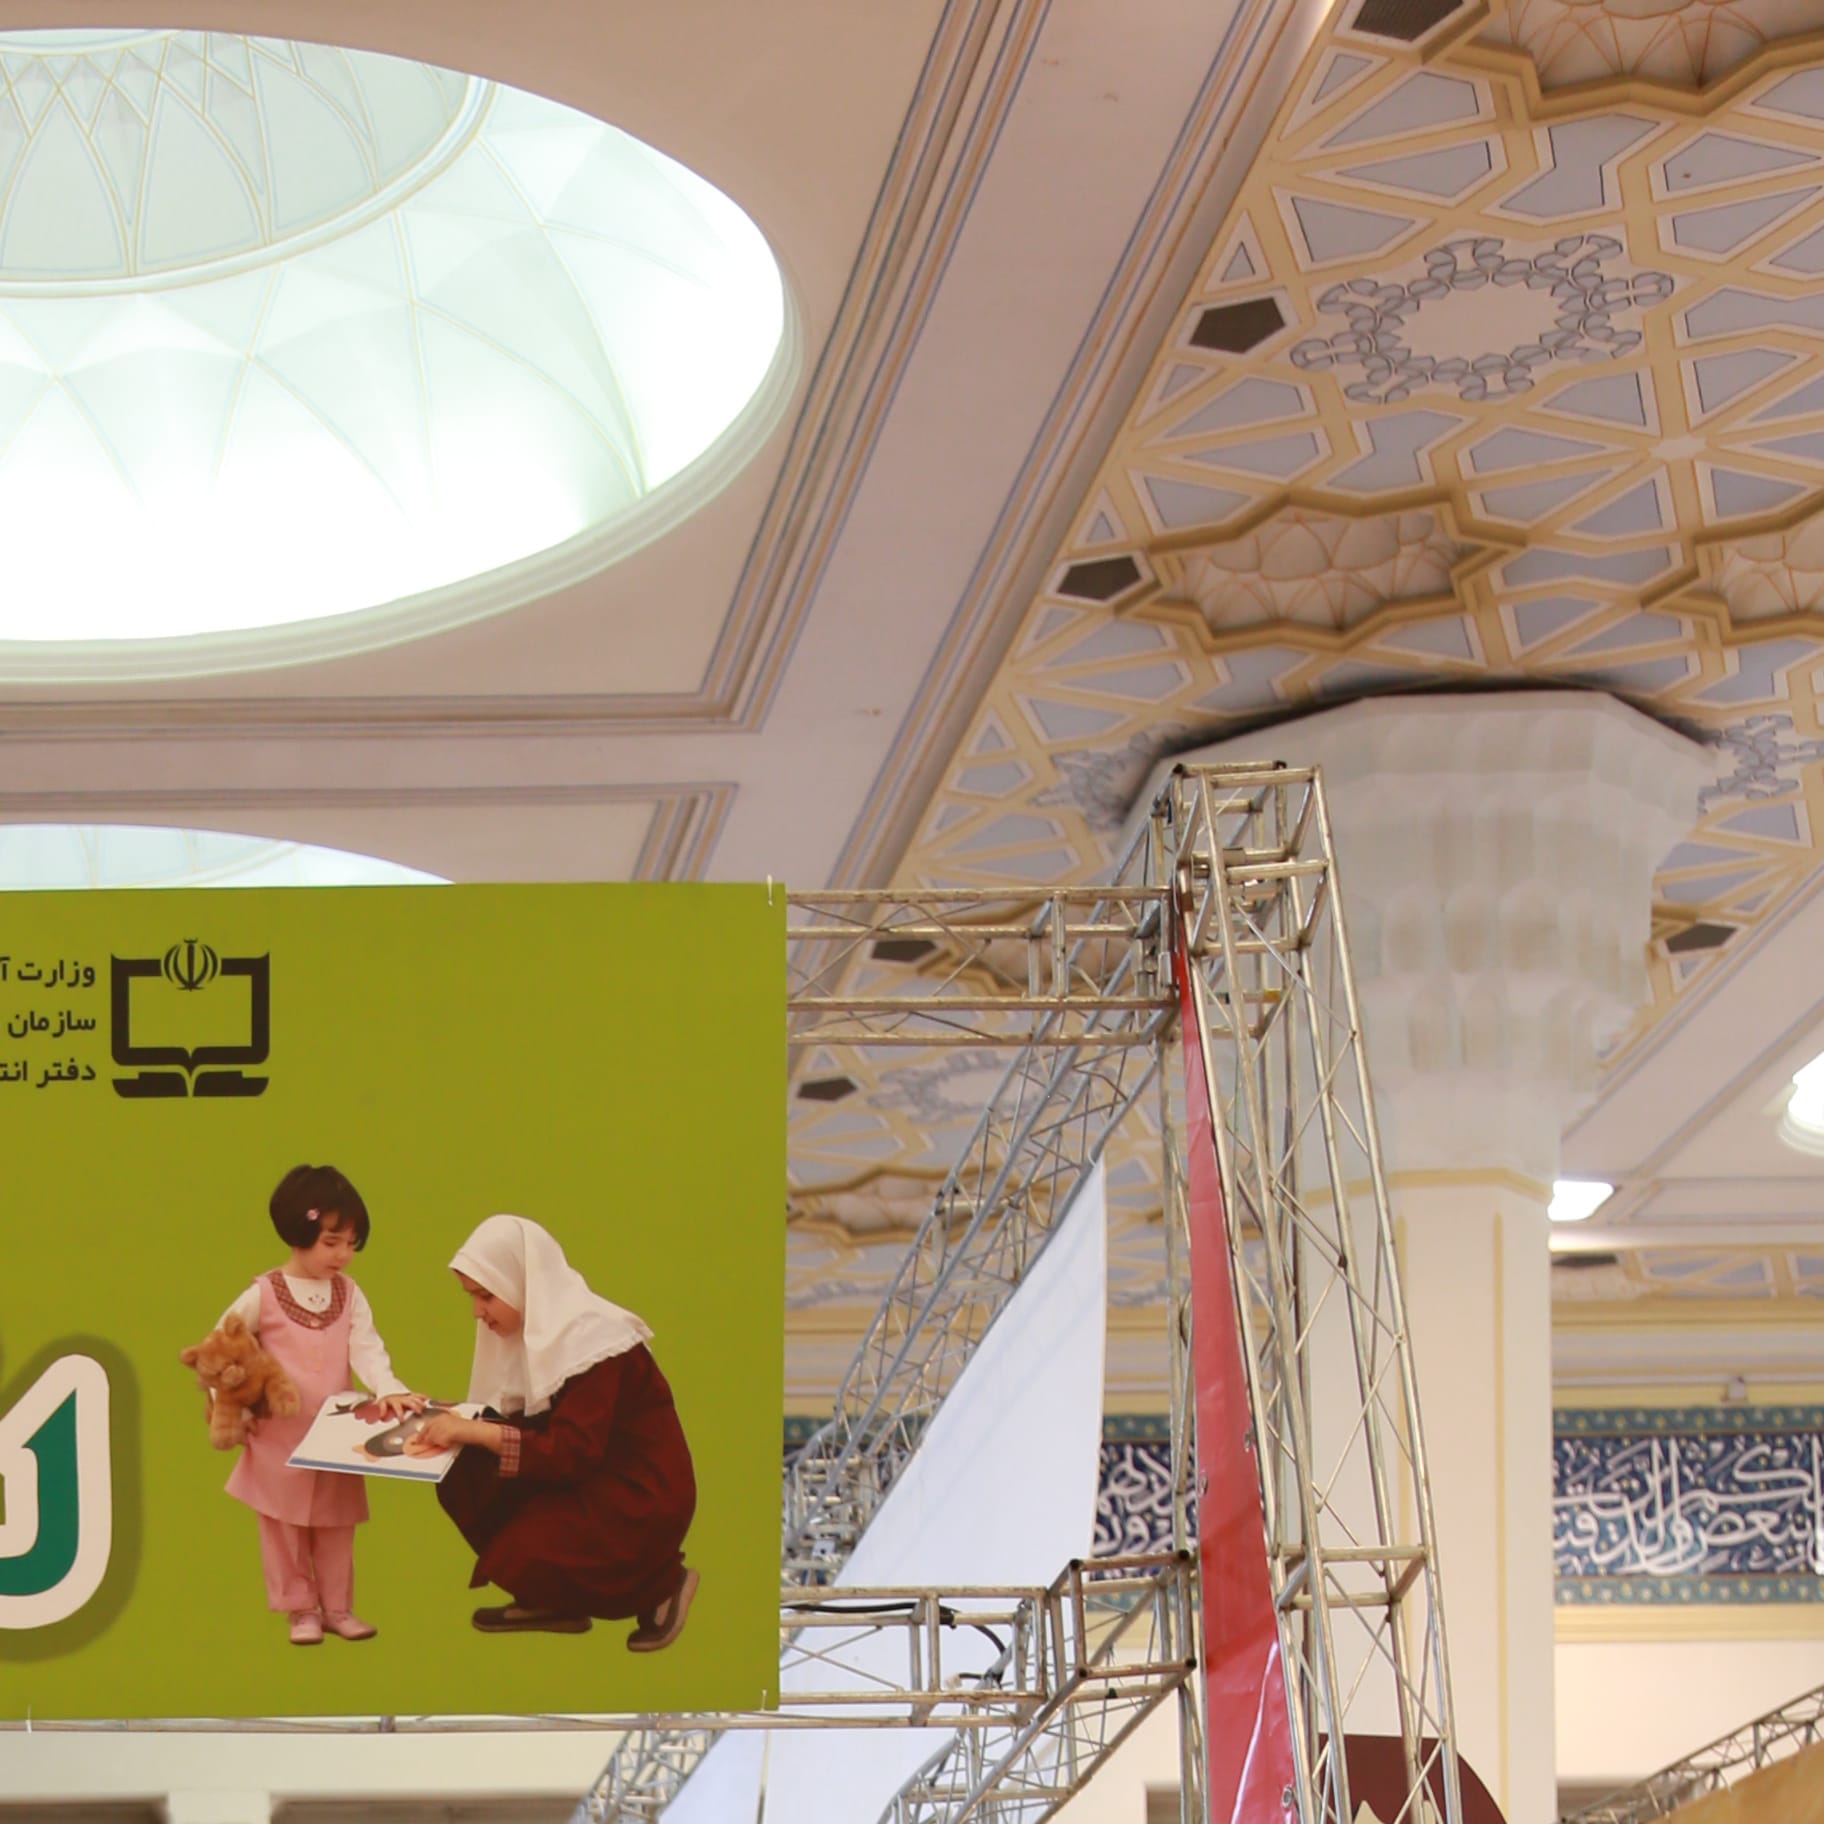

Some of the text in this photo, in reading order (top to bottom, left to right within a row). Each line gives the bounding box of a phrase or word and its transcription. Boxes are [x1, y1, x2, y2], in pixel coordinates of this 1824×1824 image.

[17, 959, 96, 988] وزارت
[7, 1009, 97, 1039] سازمان
[35, 1057, 97, 1089] دفتر
